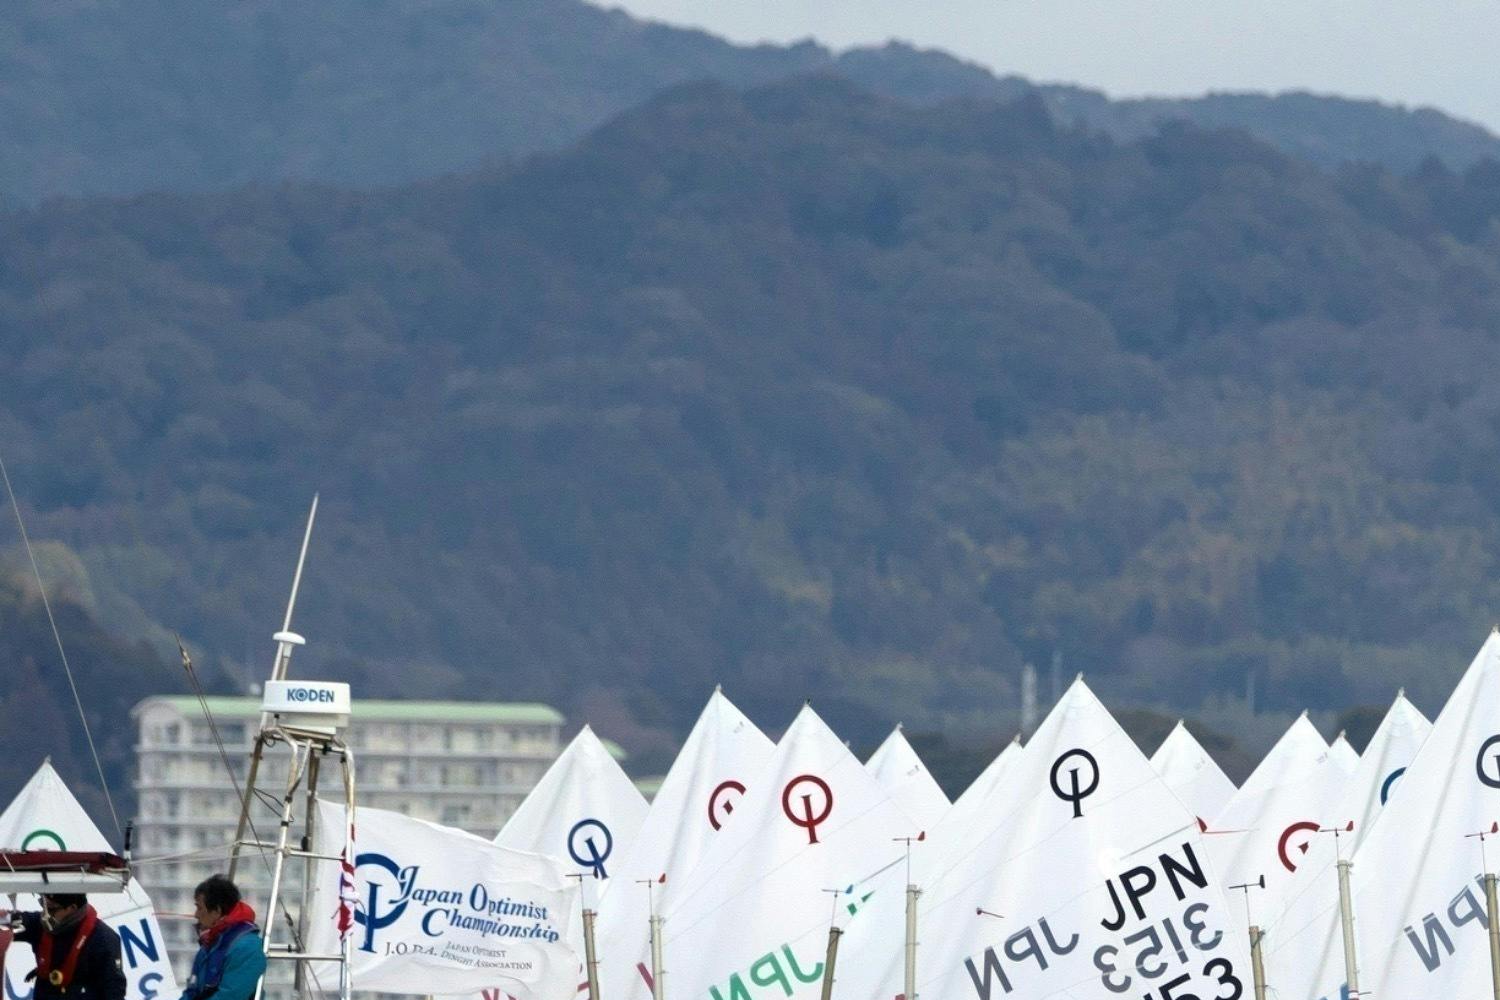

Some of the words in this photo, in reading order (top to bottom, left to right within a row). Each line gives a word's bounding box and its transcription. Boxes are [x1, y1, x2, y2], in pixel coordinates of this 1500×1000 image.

[287, 688, 334, 702] KODEN
[389, 866, 463, 907] Japan
[470, 883, 548, 920] Optimist
[1101, 842, 1208, 931] JPN
[422, 908, 559, 943] Championship
